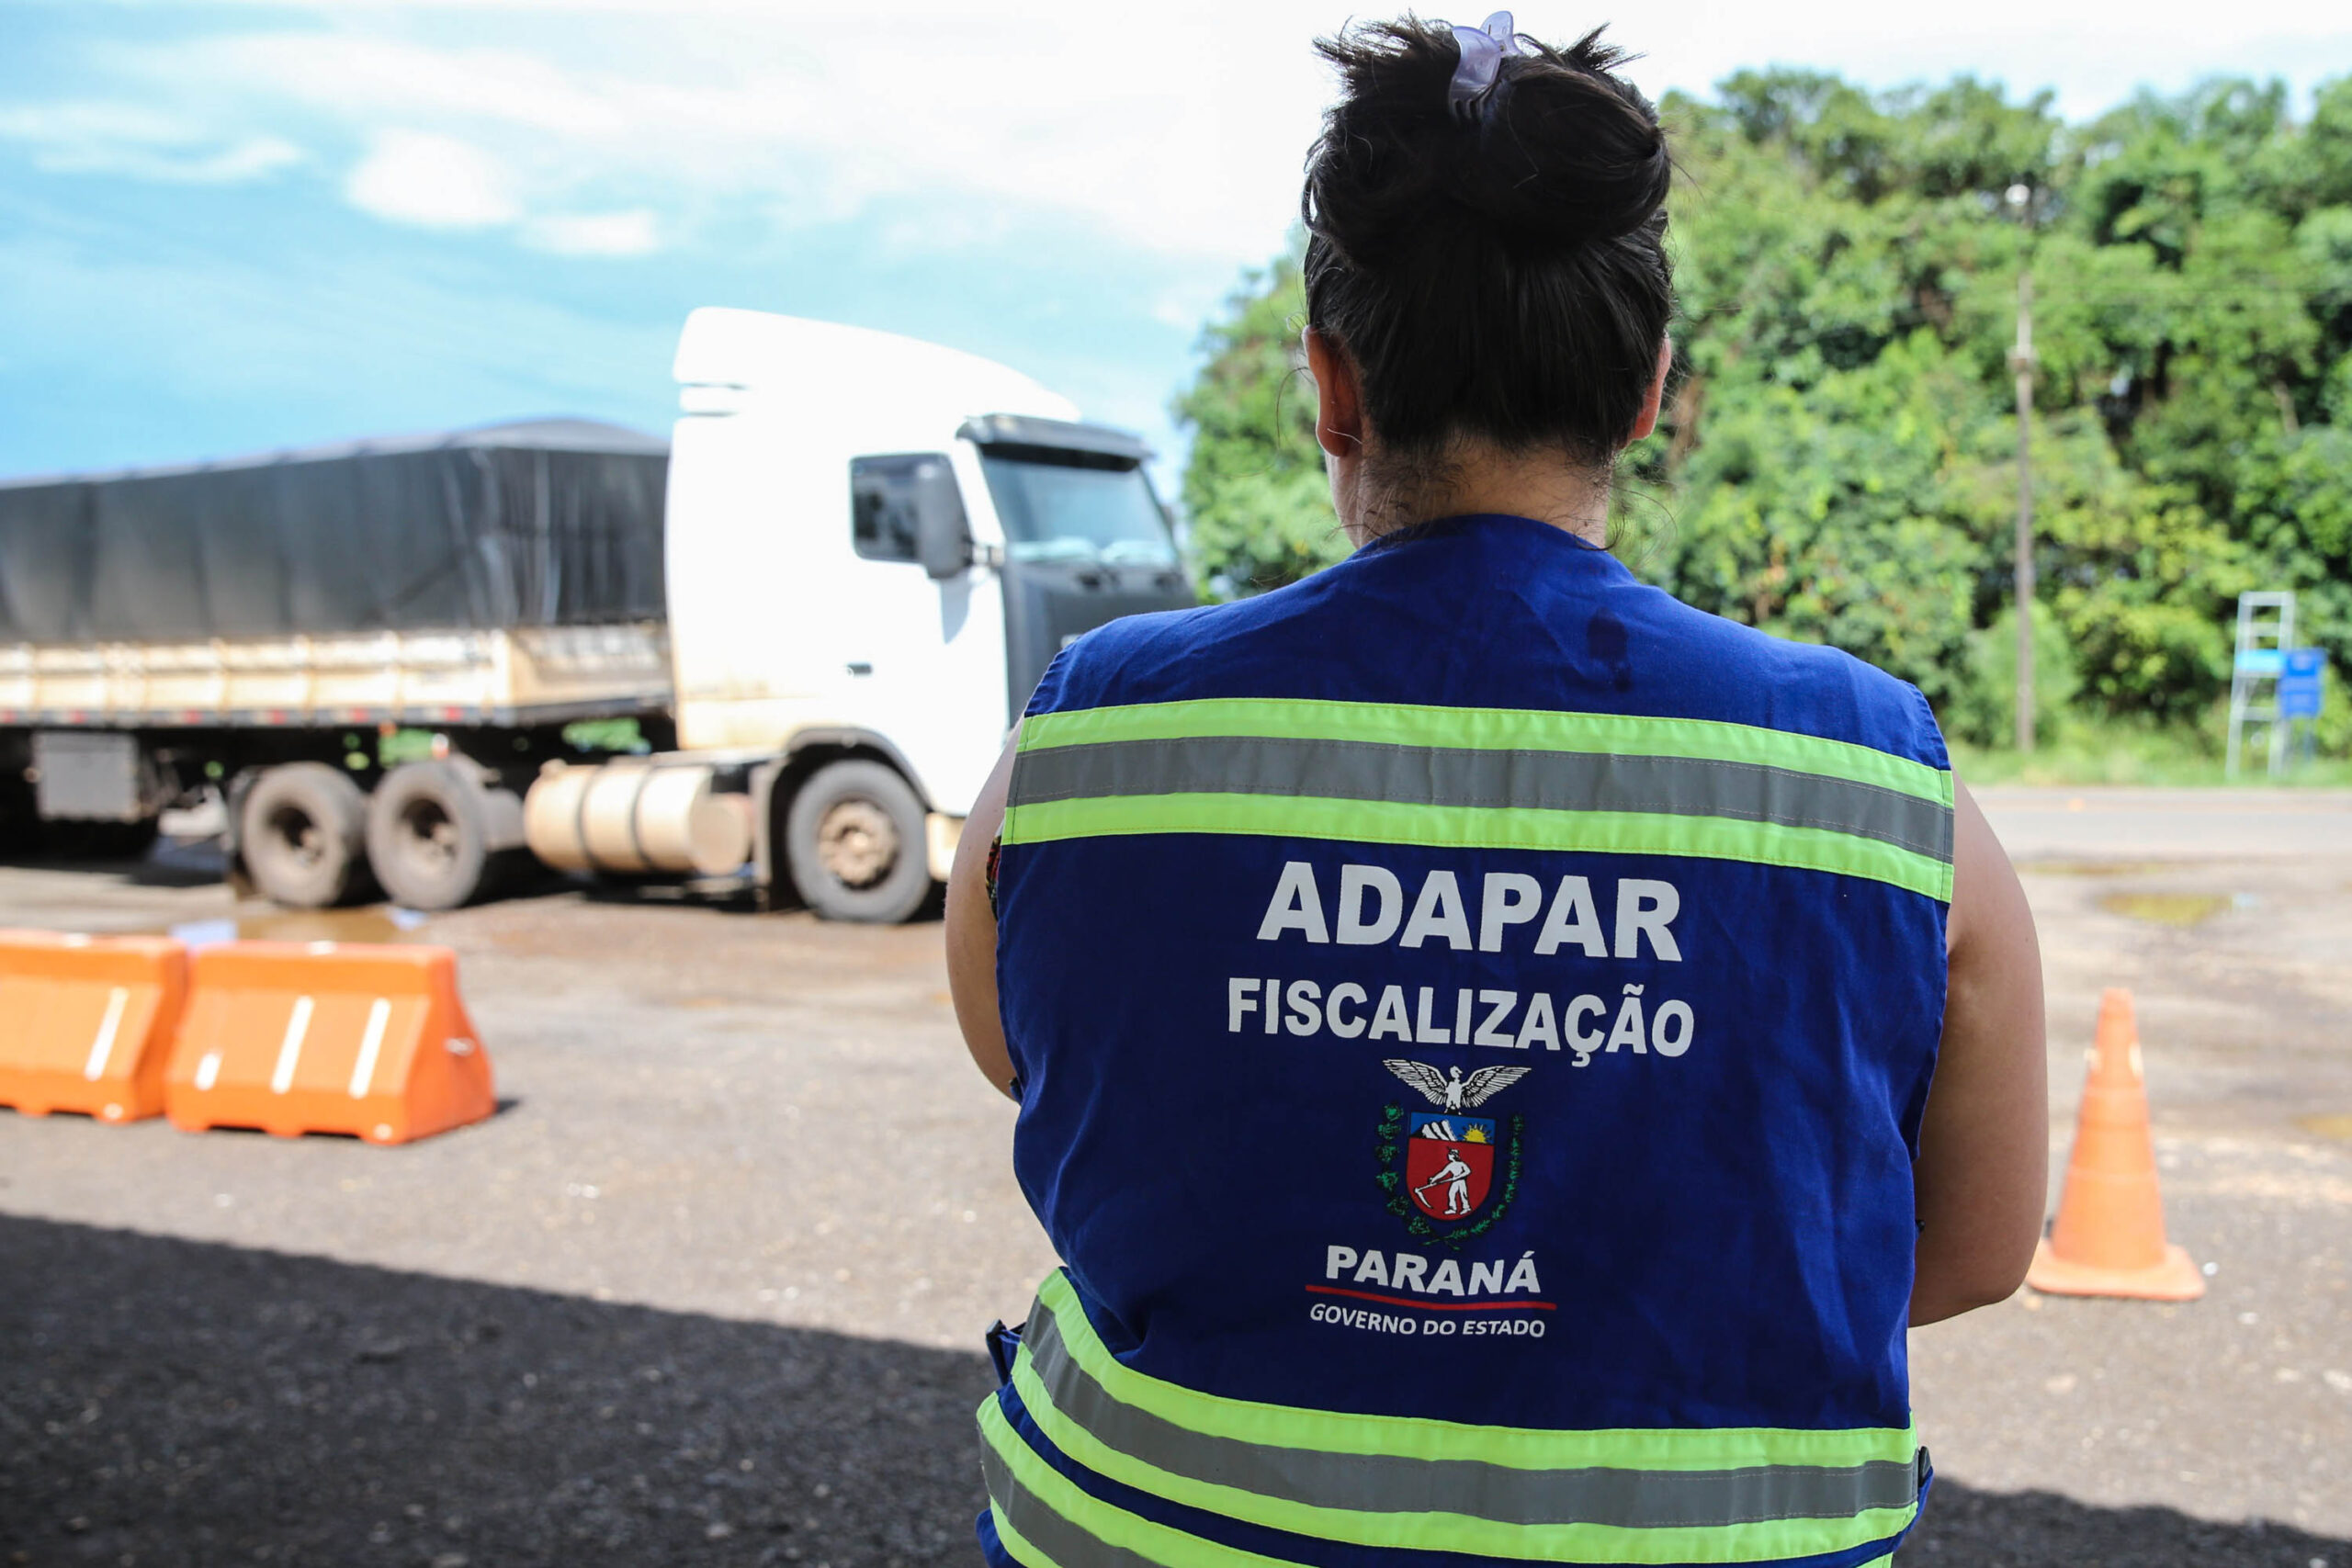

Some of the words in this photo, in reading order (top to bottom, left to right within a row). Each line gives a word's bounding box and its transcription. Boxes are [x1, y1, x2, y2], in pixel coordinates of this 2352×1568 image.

[1257, 861, 1682, 962] ADAPAR
[1228, 976, 1694, 1067] FISCALIZAÇÃO
[1326, 1245, 1541, 1296] PARANÁ
[1309, 1303, 1417, 1336] GOVERNO
[1422, 1318, 1456, 1336] DO
[1463, 1319, 1545, 1338] ESTADO
